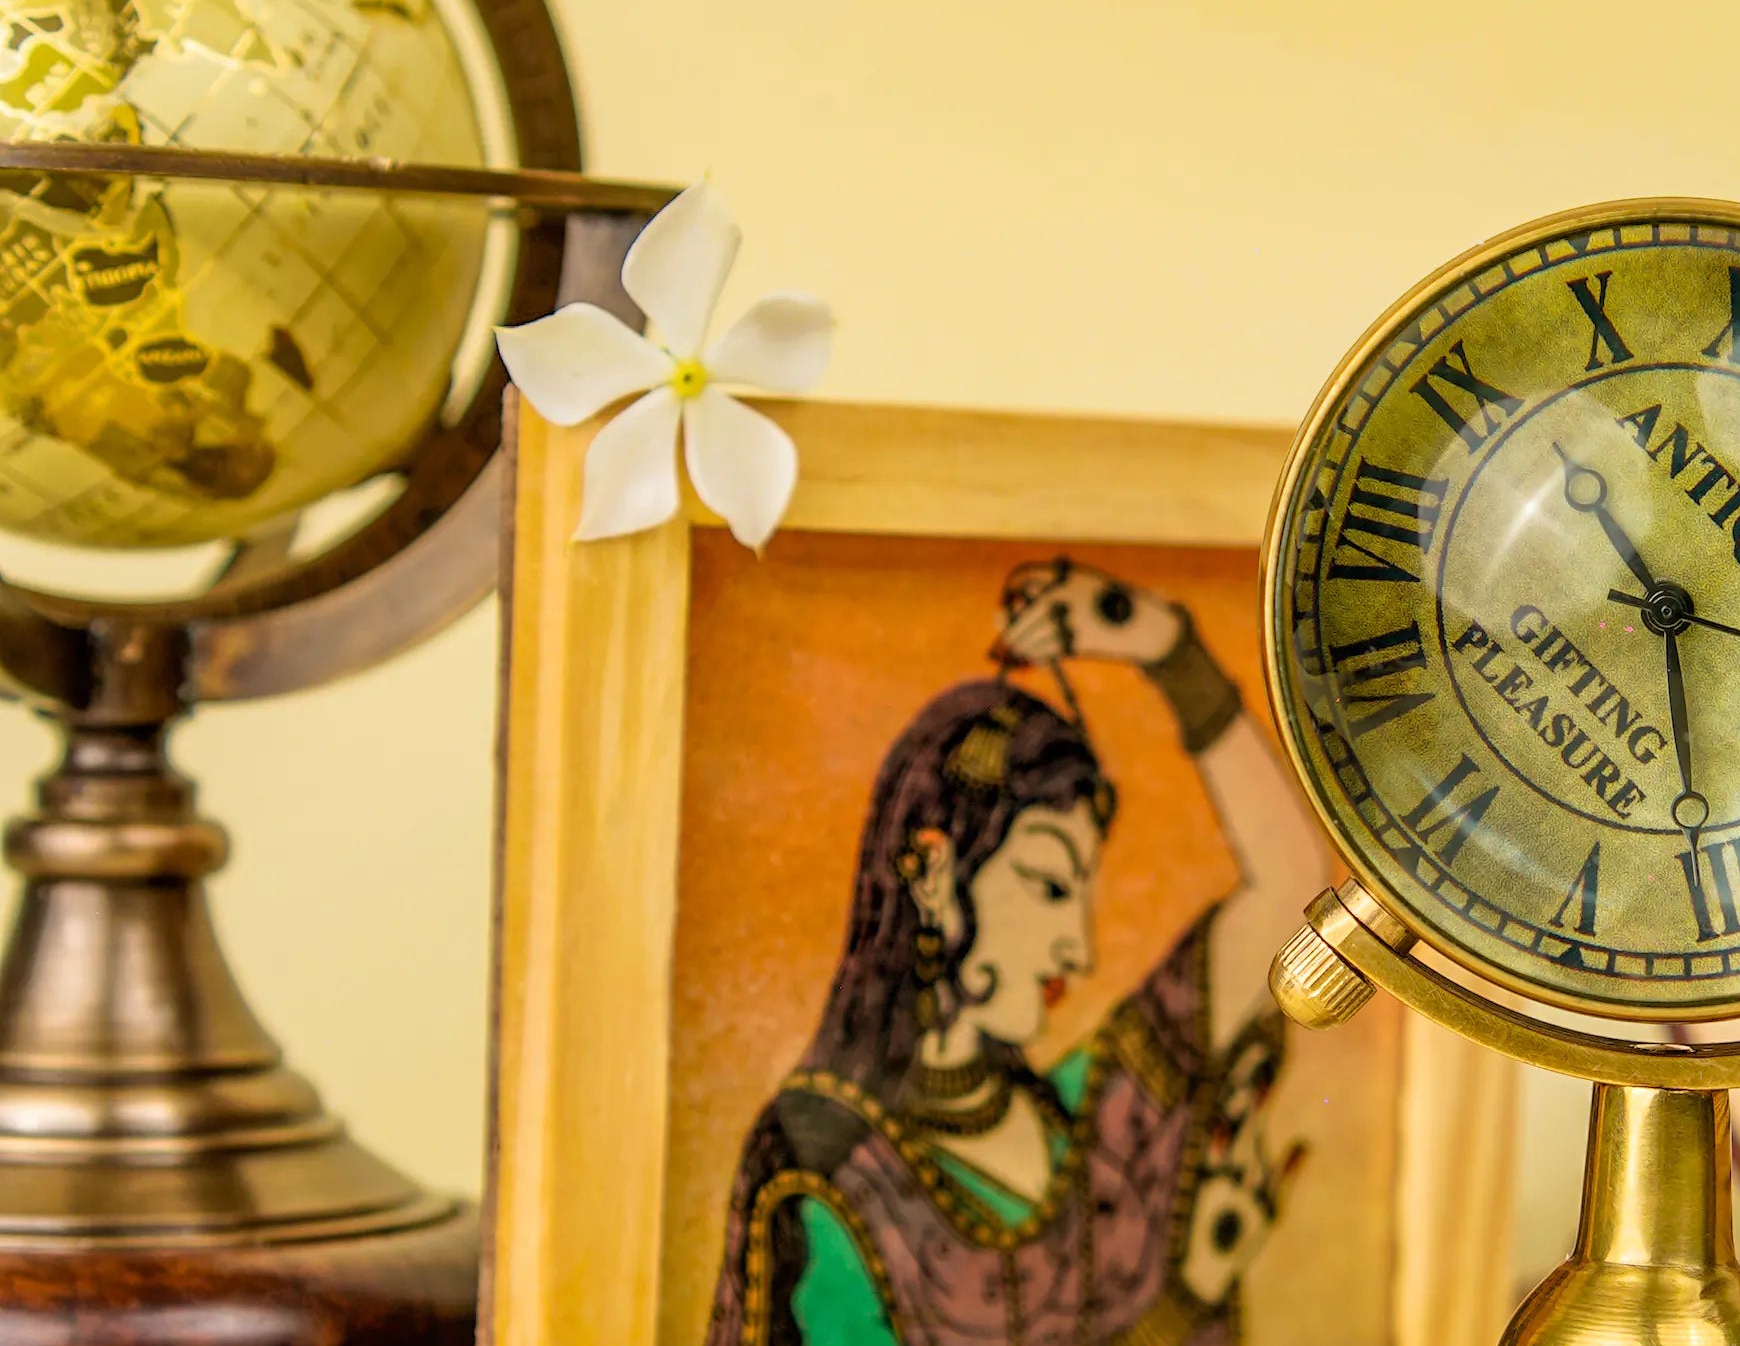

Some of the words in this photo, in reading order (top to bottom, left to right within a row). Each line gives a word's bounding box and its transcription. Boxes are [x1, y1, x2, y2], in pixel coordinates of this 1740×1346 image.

[1566, 270, 1634, 371] X
[1409, 339, 1526, 456] IX
[1326, 456, 1450, 583] VIII
[1328, 619, 1437, 742] VII
[1452, 618, 1647, 820] PLEASURE
[1510, 604, 1668, 765] GIFTING
[1401, 753, 1501, 871] VI
[1549, 841, 1602, 938] V
